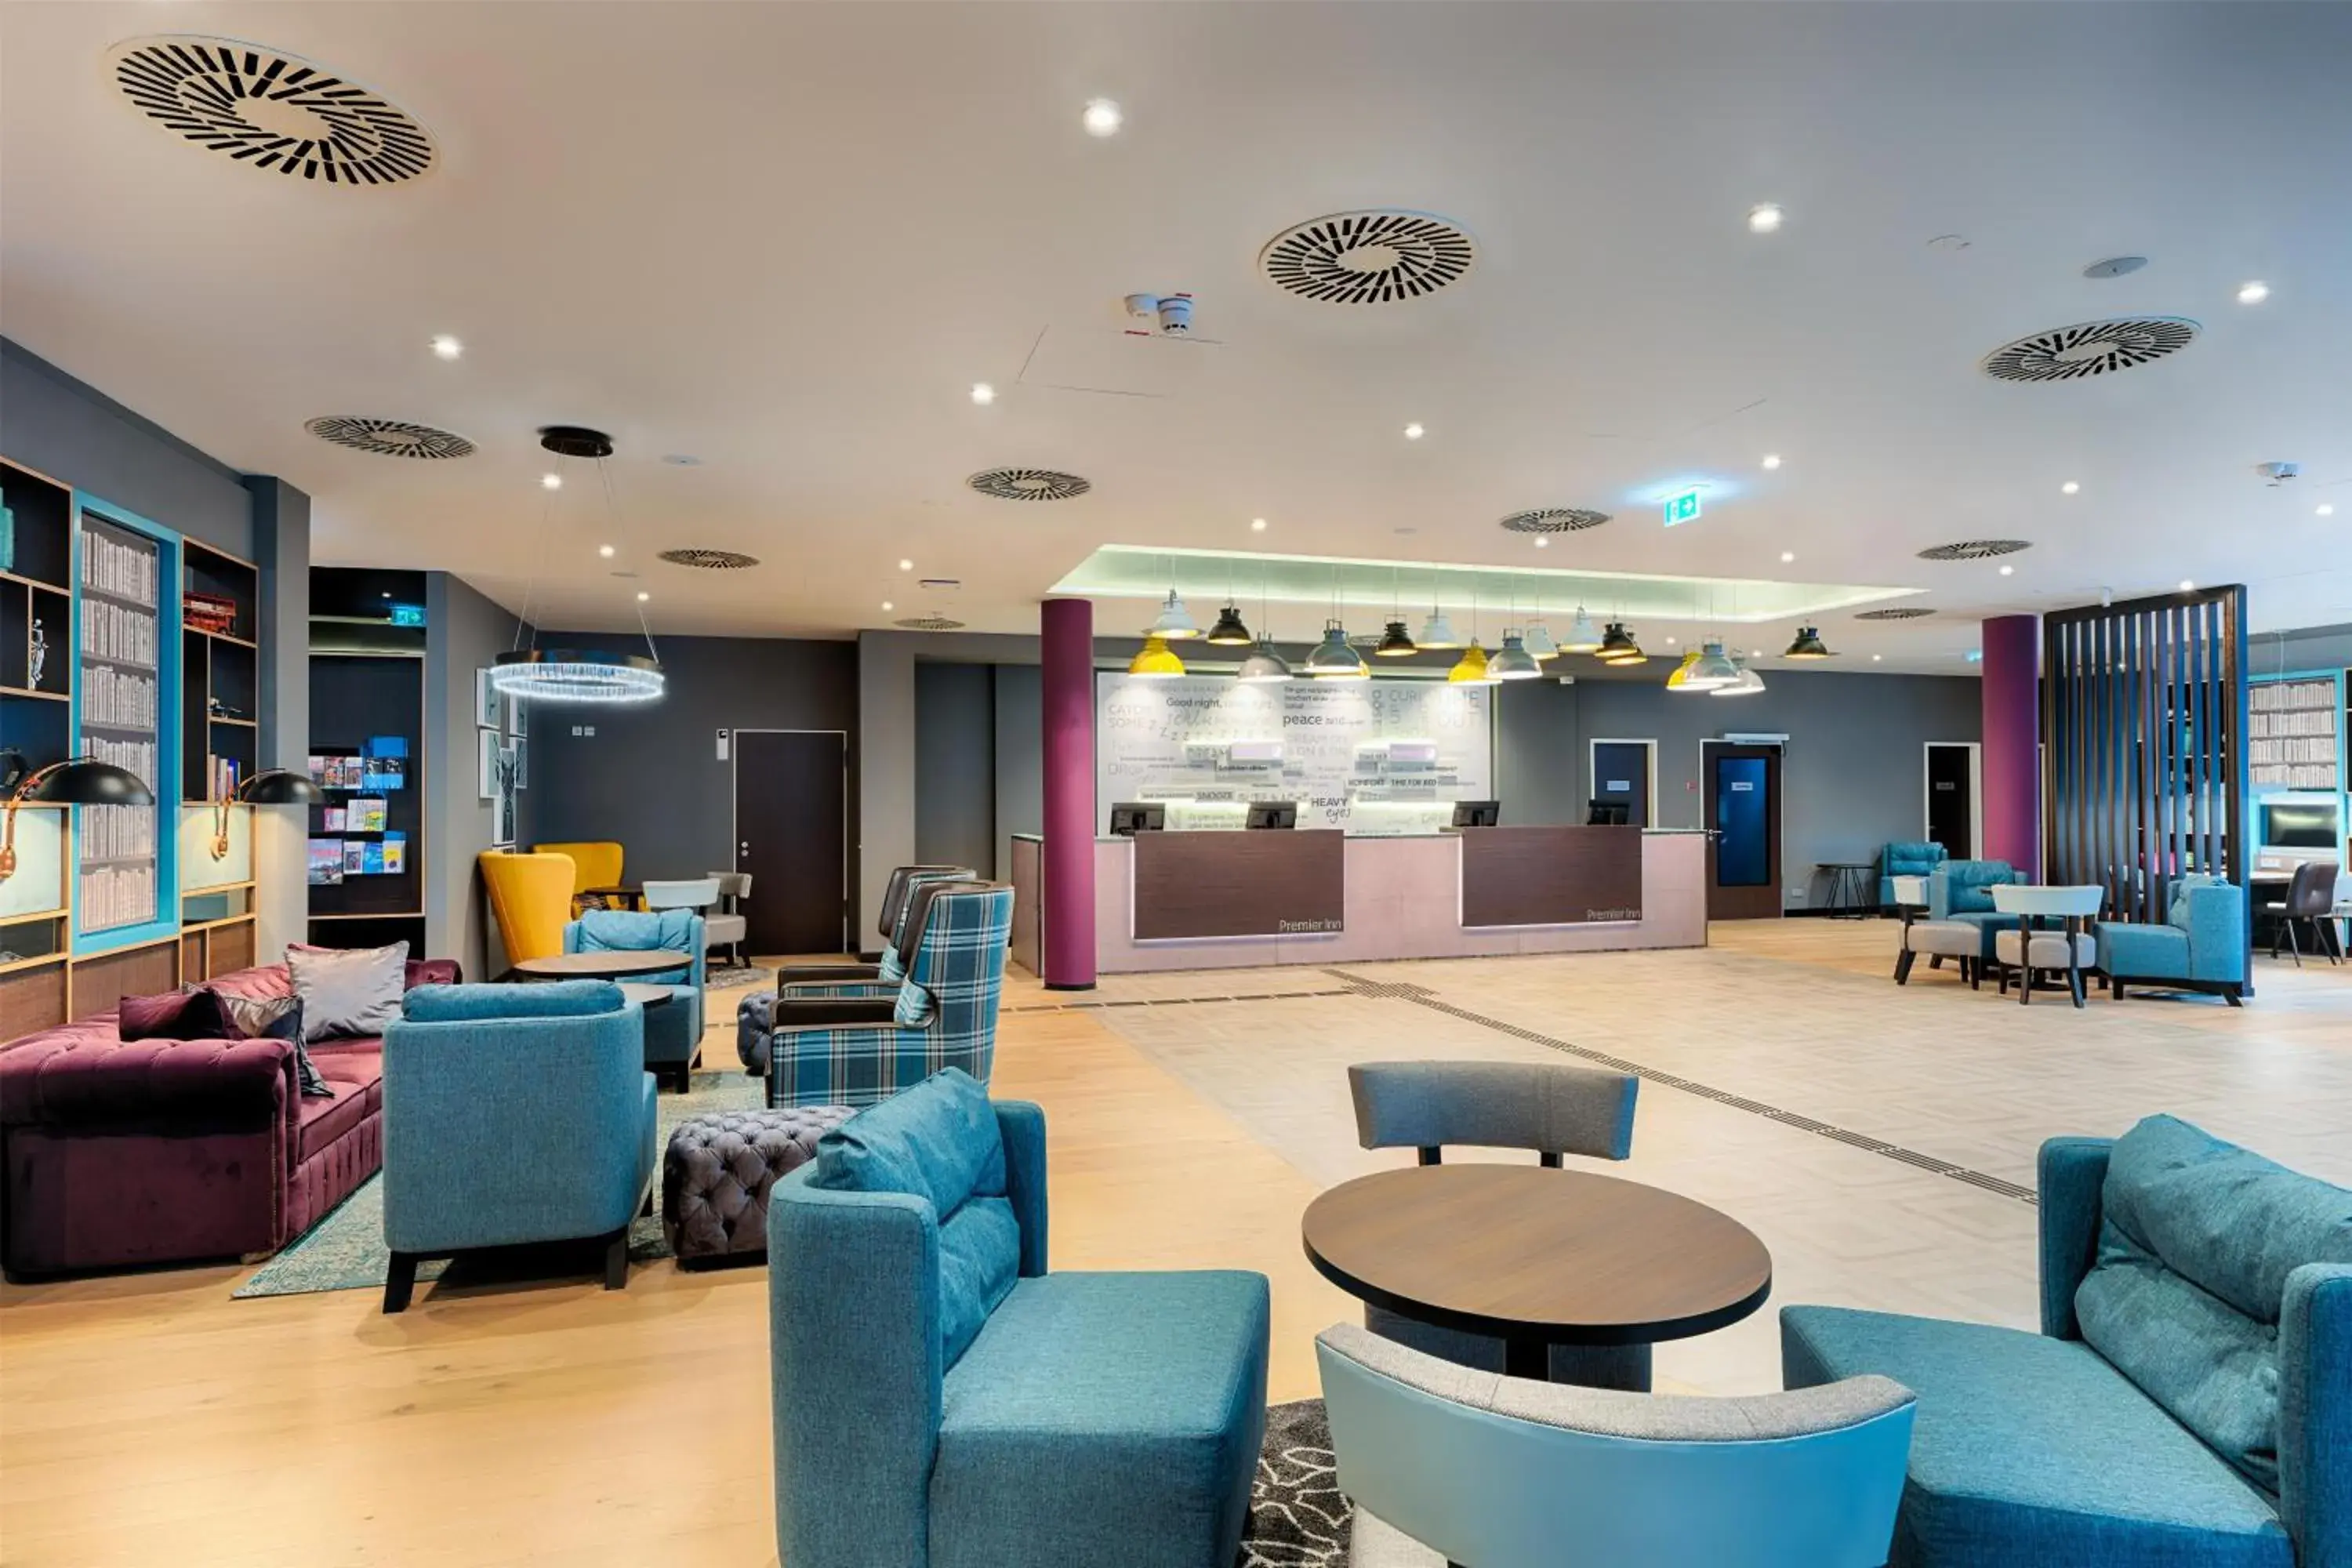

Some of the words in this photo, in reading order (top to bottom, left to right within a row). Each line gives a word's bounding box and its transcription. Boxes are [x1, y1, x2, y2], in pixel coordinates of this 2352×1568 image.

[1166, 697, 1192, 706] Good
[1194, 697, 1222, 709] night,
[1283, 714, 1323, 728] peace
[1311, 797, 1348, 808] HEAVY
[1279, 919, 1323, 932] Premier
[1324, 918, 1341, 929] Inn
